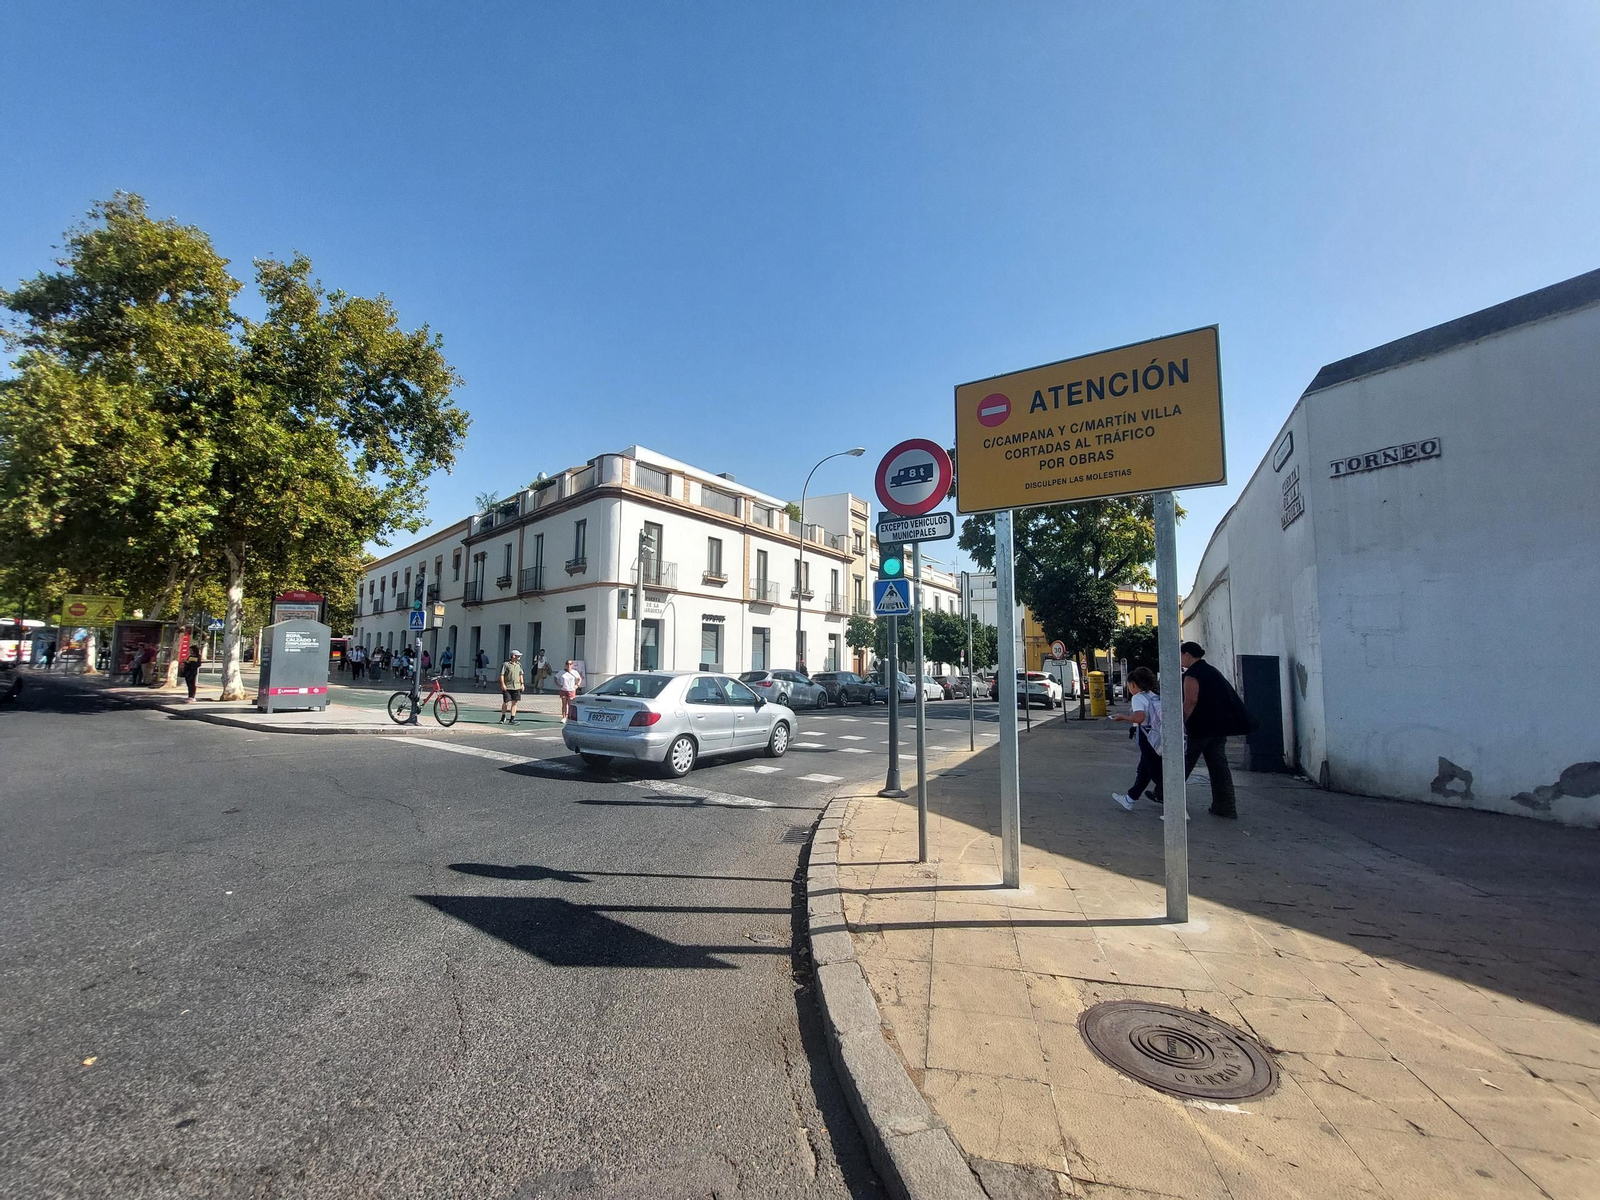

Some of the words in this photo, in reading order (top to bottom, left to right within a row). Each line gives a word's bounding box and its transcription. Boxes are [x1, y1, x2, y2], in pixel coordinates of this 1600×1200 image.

[1029, 357, 1190, 414] ATENCIÓN
[983, 427, 1054, 449] C/CAMPANA
[1058, 425, 1067, 436] Y
[1070, 411, 1137, 434] C/MARTÍN
[1141, 404, 1182, 421] VILLA
[1004, 440, 1071, 461] CORTADAS
[1075, 437, 1091, 450] AL
[1095, 426, 1155, 446] TRÁFICO
[1039, 457, 1065, 471] POR
[1069, 449, 1115, 466] OBRAS
[1330, 440, 1437, 474] TORNEO
[909, 468, 916, 478] 8
[919, 467, 925, 476] t
[1025, 477, 1067, 490] DISCULPEN
[1069, 475, 1084, 484] LAS
[1086, 468, 1133, 481] MOLESTIAS
[880, 521, 909, 533] EXCEPTO
[910, 515, 948, 529] VEHICULOS
[892, 527, 937, 541] MUNICIPALES
[1053, 646, 1062, 654] 30
